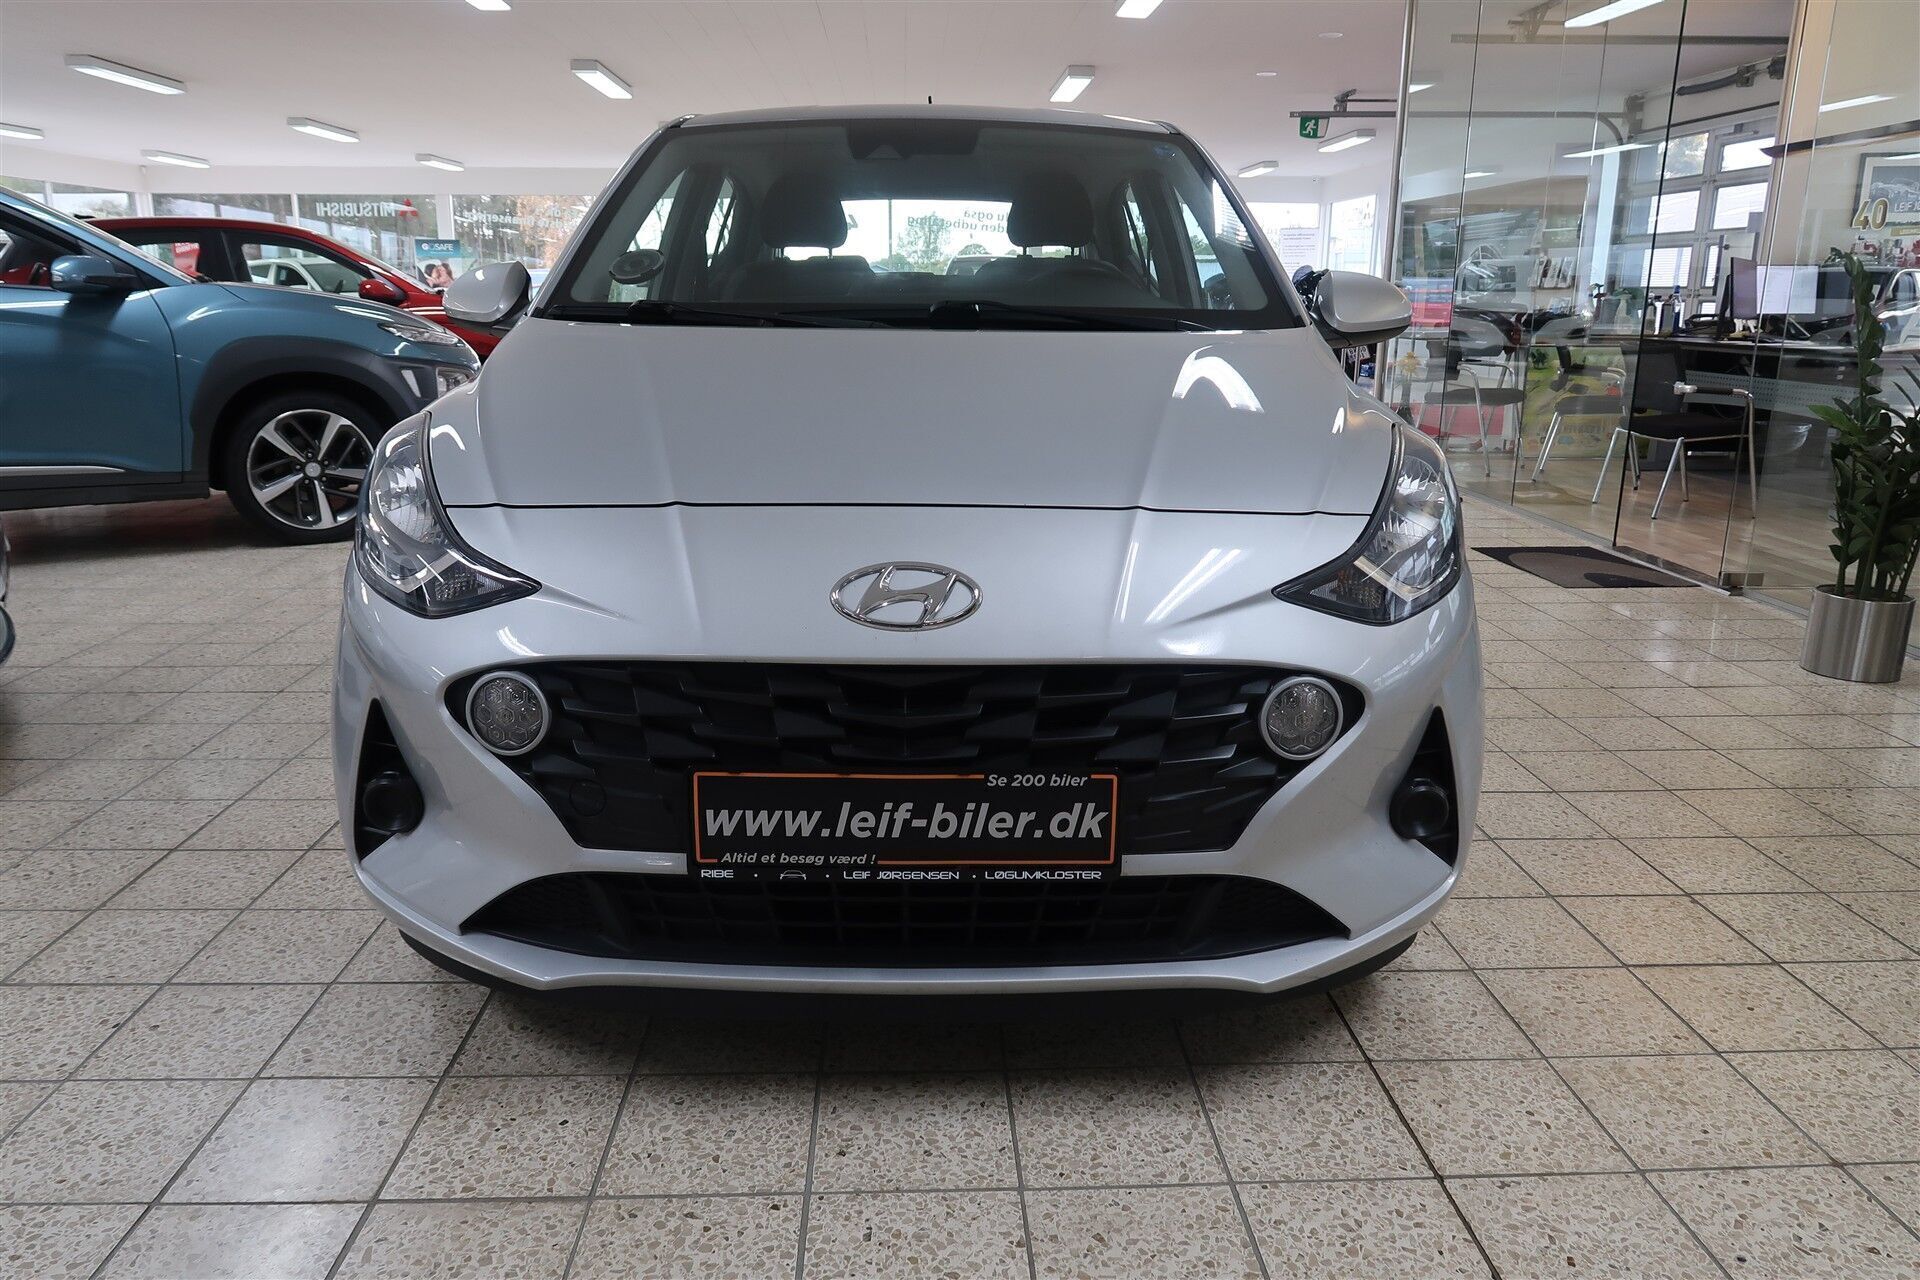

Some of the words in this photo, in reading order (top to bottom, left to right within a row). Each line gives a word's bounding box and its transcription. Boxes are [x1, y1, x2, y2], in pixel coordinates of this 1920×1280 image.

[1851, 198, 1889, 231] 40
[987, 774, 1008, 787] Se
[1011, 774, 1046, 787] 200
[1050, 774, 1088, 787] biler
[705, 802, 1108, 838] www.leif-biler.dk
[721, 852, 757, 864] Altid
[761, 854, 776, 864] et
[780, 853, 825, 866] besøg
[829, 854, 867, 865] værd
[701, 869, 734, 879] RIBE
[843, 870, 871, 880] LEIF
[877, 870, 960, 880] JØRGENSEN
[985, 871, 1102, 880] LØGUMKLOSTER
